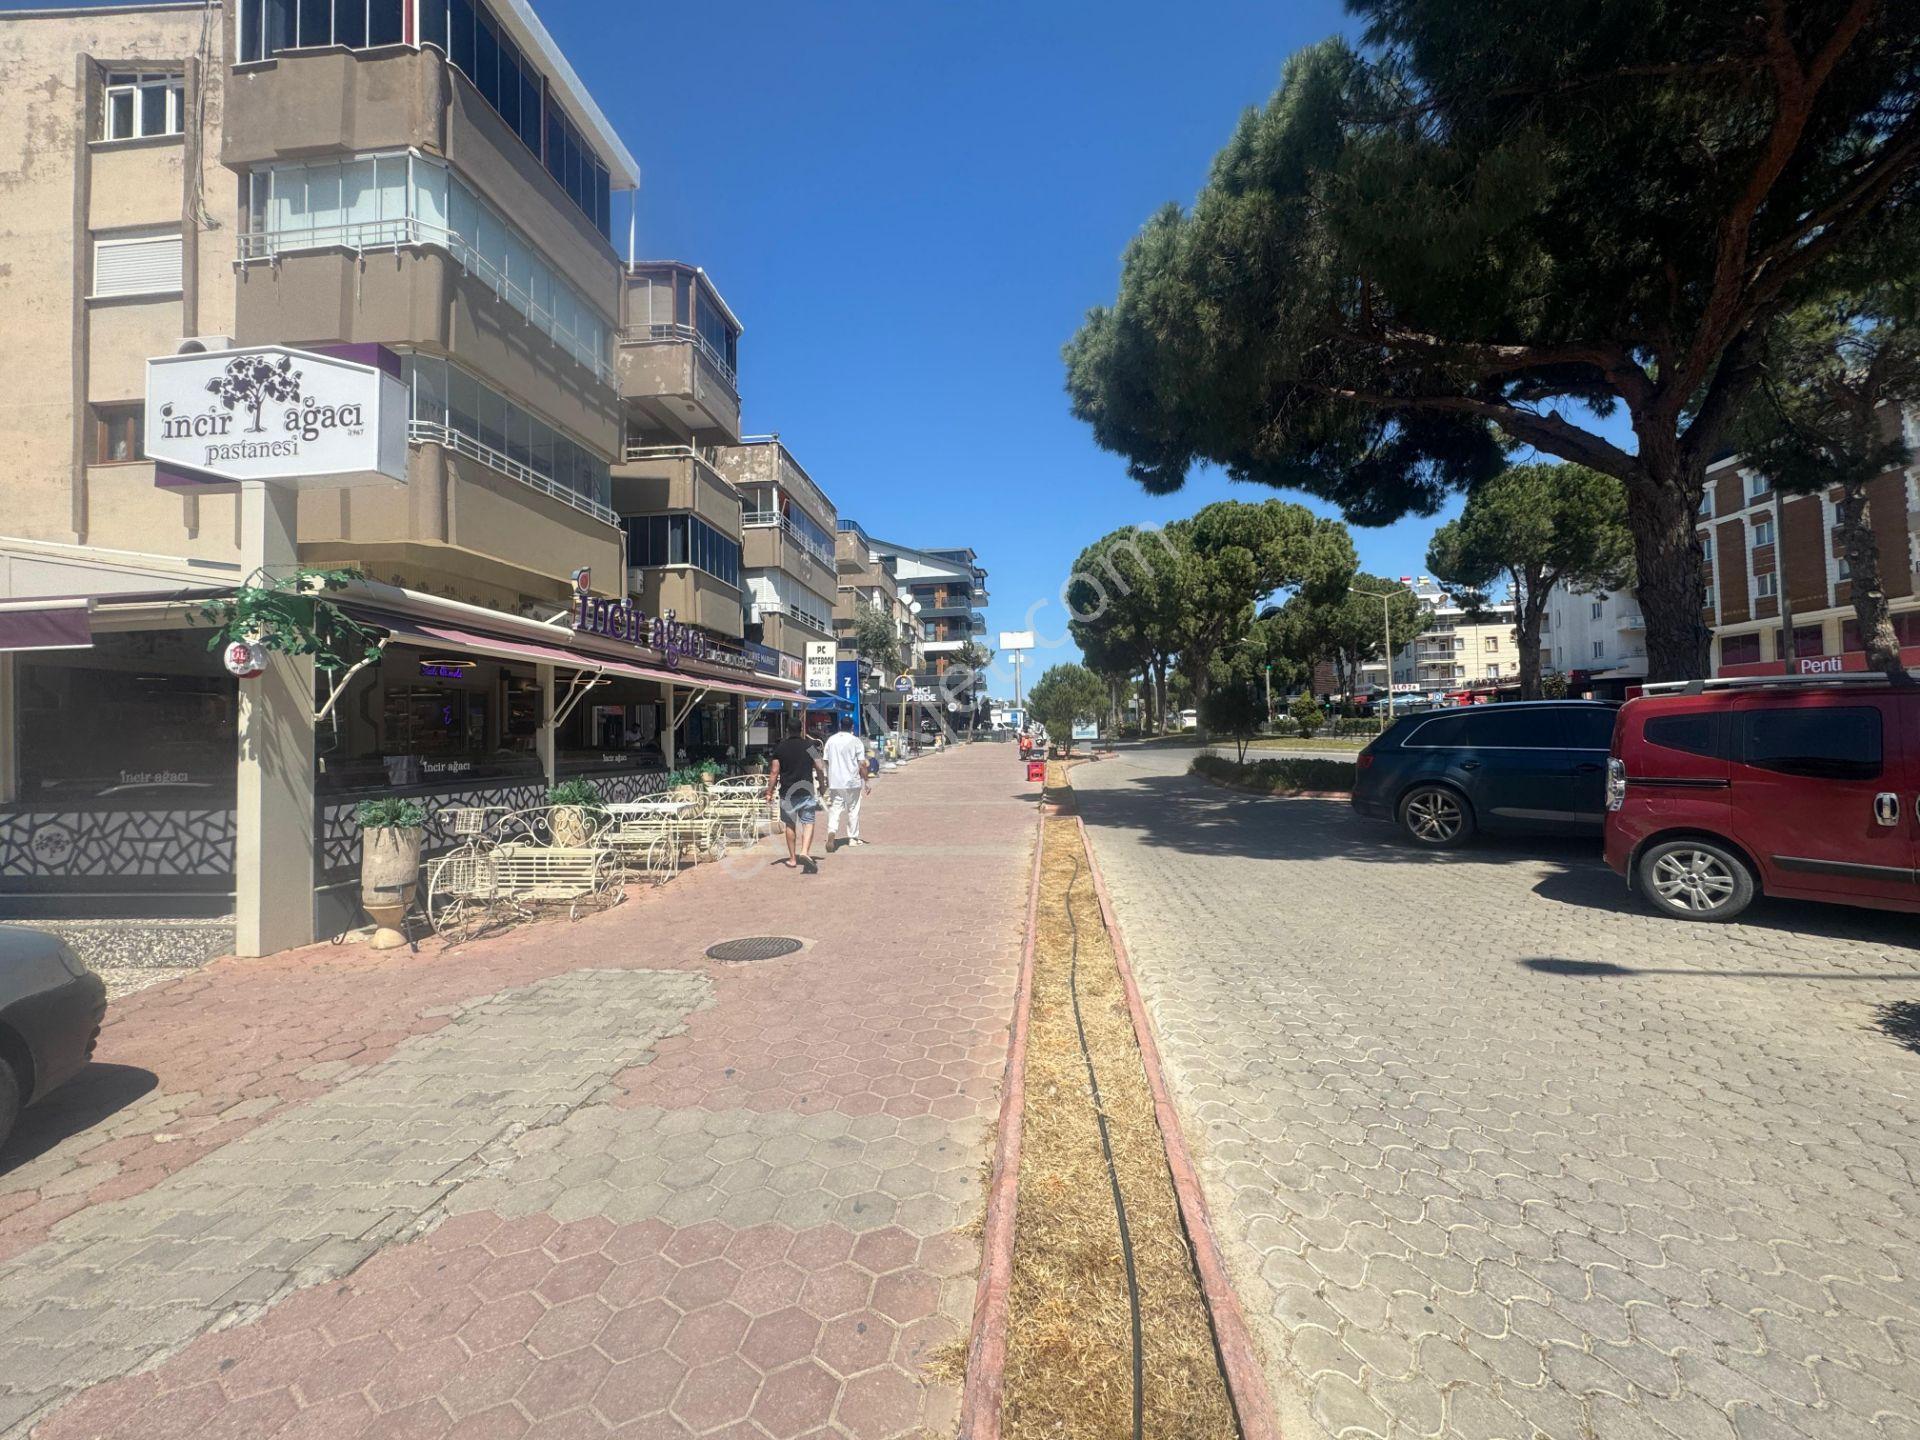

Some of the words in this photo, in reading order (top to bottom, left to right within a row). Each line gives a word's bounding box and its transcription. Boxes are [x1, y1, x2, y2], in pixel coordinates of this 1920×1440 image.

[162, 402, 233, 439] incir
[285, 396, 364, 441] ağacı
[205, 436, 300, 465] pastanesi
[816, 645, 827, 655] PC
[808, 656, 834, 665] NOTEBOOK
[1801, 657, 1842, 674] Penti
[906, 694, 937, 702] PERDE
